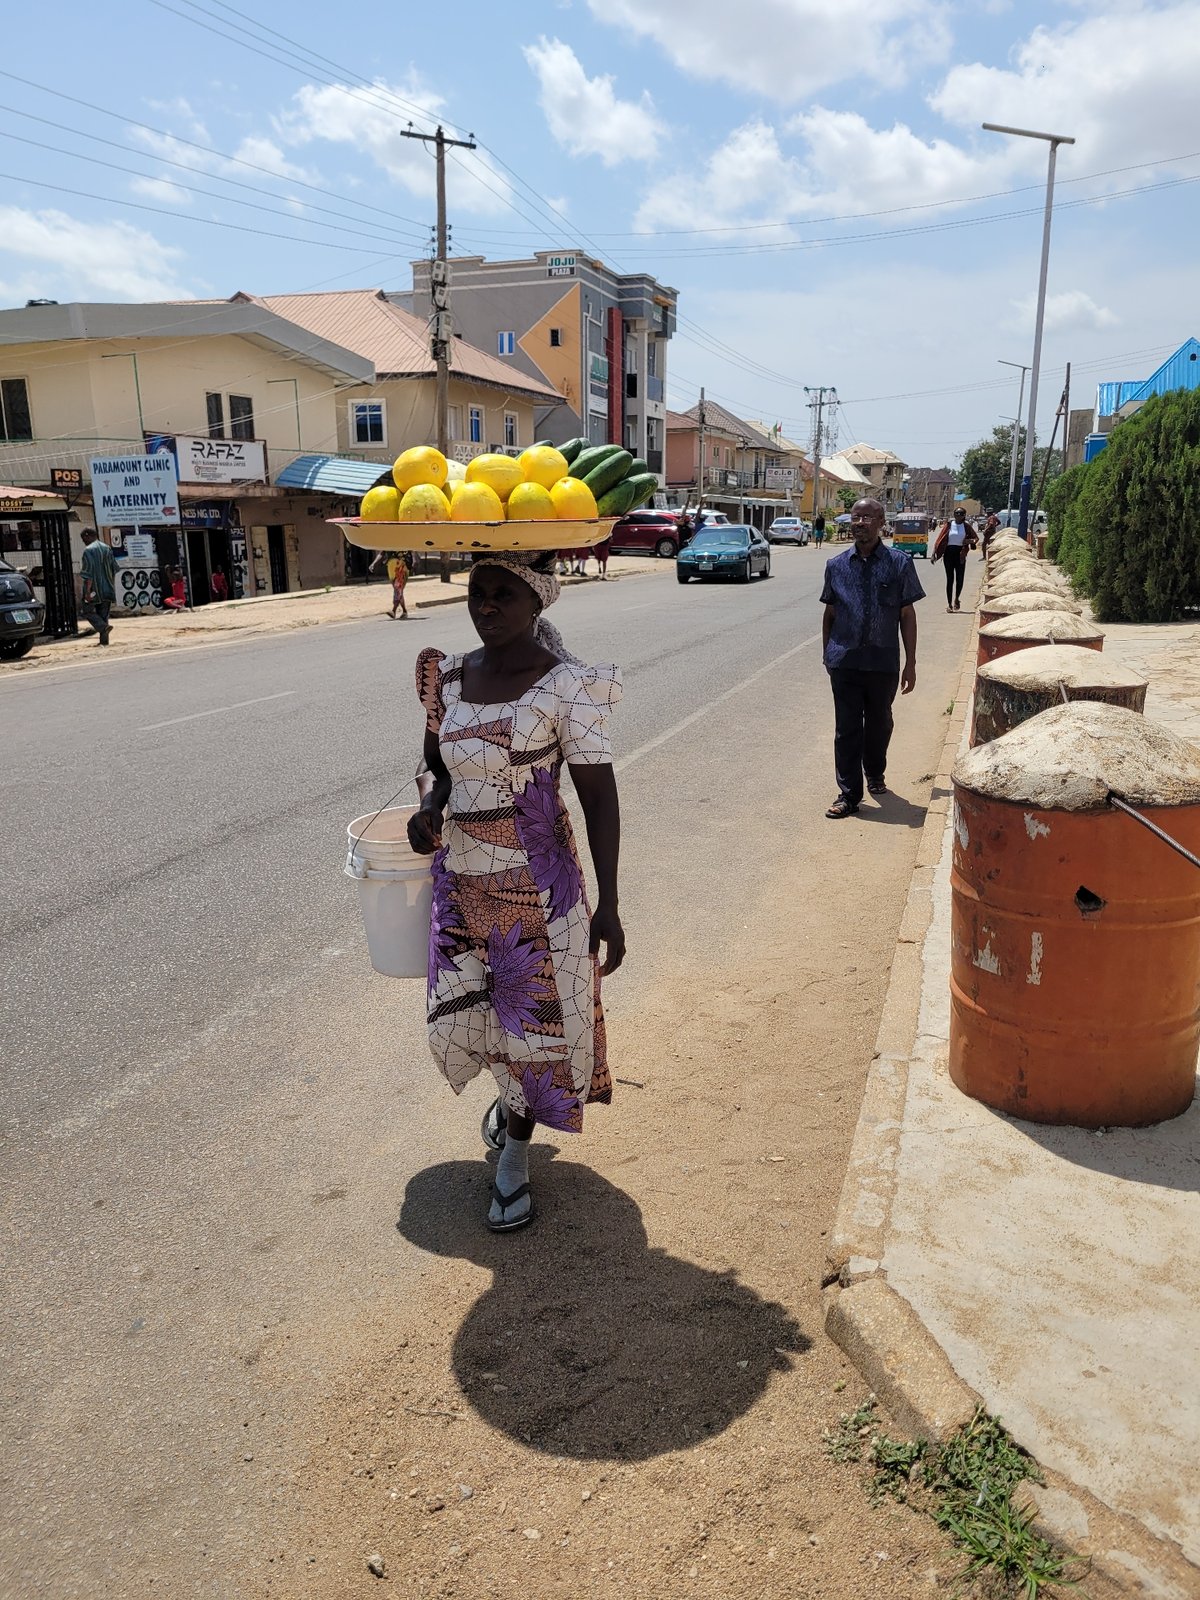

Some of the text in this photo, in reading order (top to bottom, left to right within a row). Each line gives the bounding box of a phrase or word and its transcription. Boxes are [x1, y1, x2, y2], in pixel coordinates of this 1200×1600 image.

[548, 258, 574, 266] JOJO
[552, 268, 570, 276] PLAZA
[191, 440, 245, 460] RAFAZ
[93, 458, 170, 474] PARAMOUNT CLINIC
[54, 470, 80, 482] POS
[124, 476, 140, 487] AND
[102, 492, 167, 508] MATERNITY
